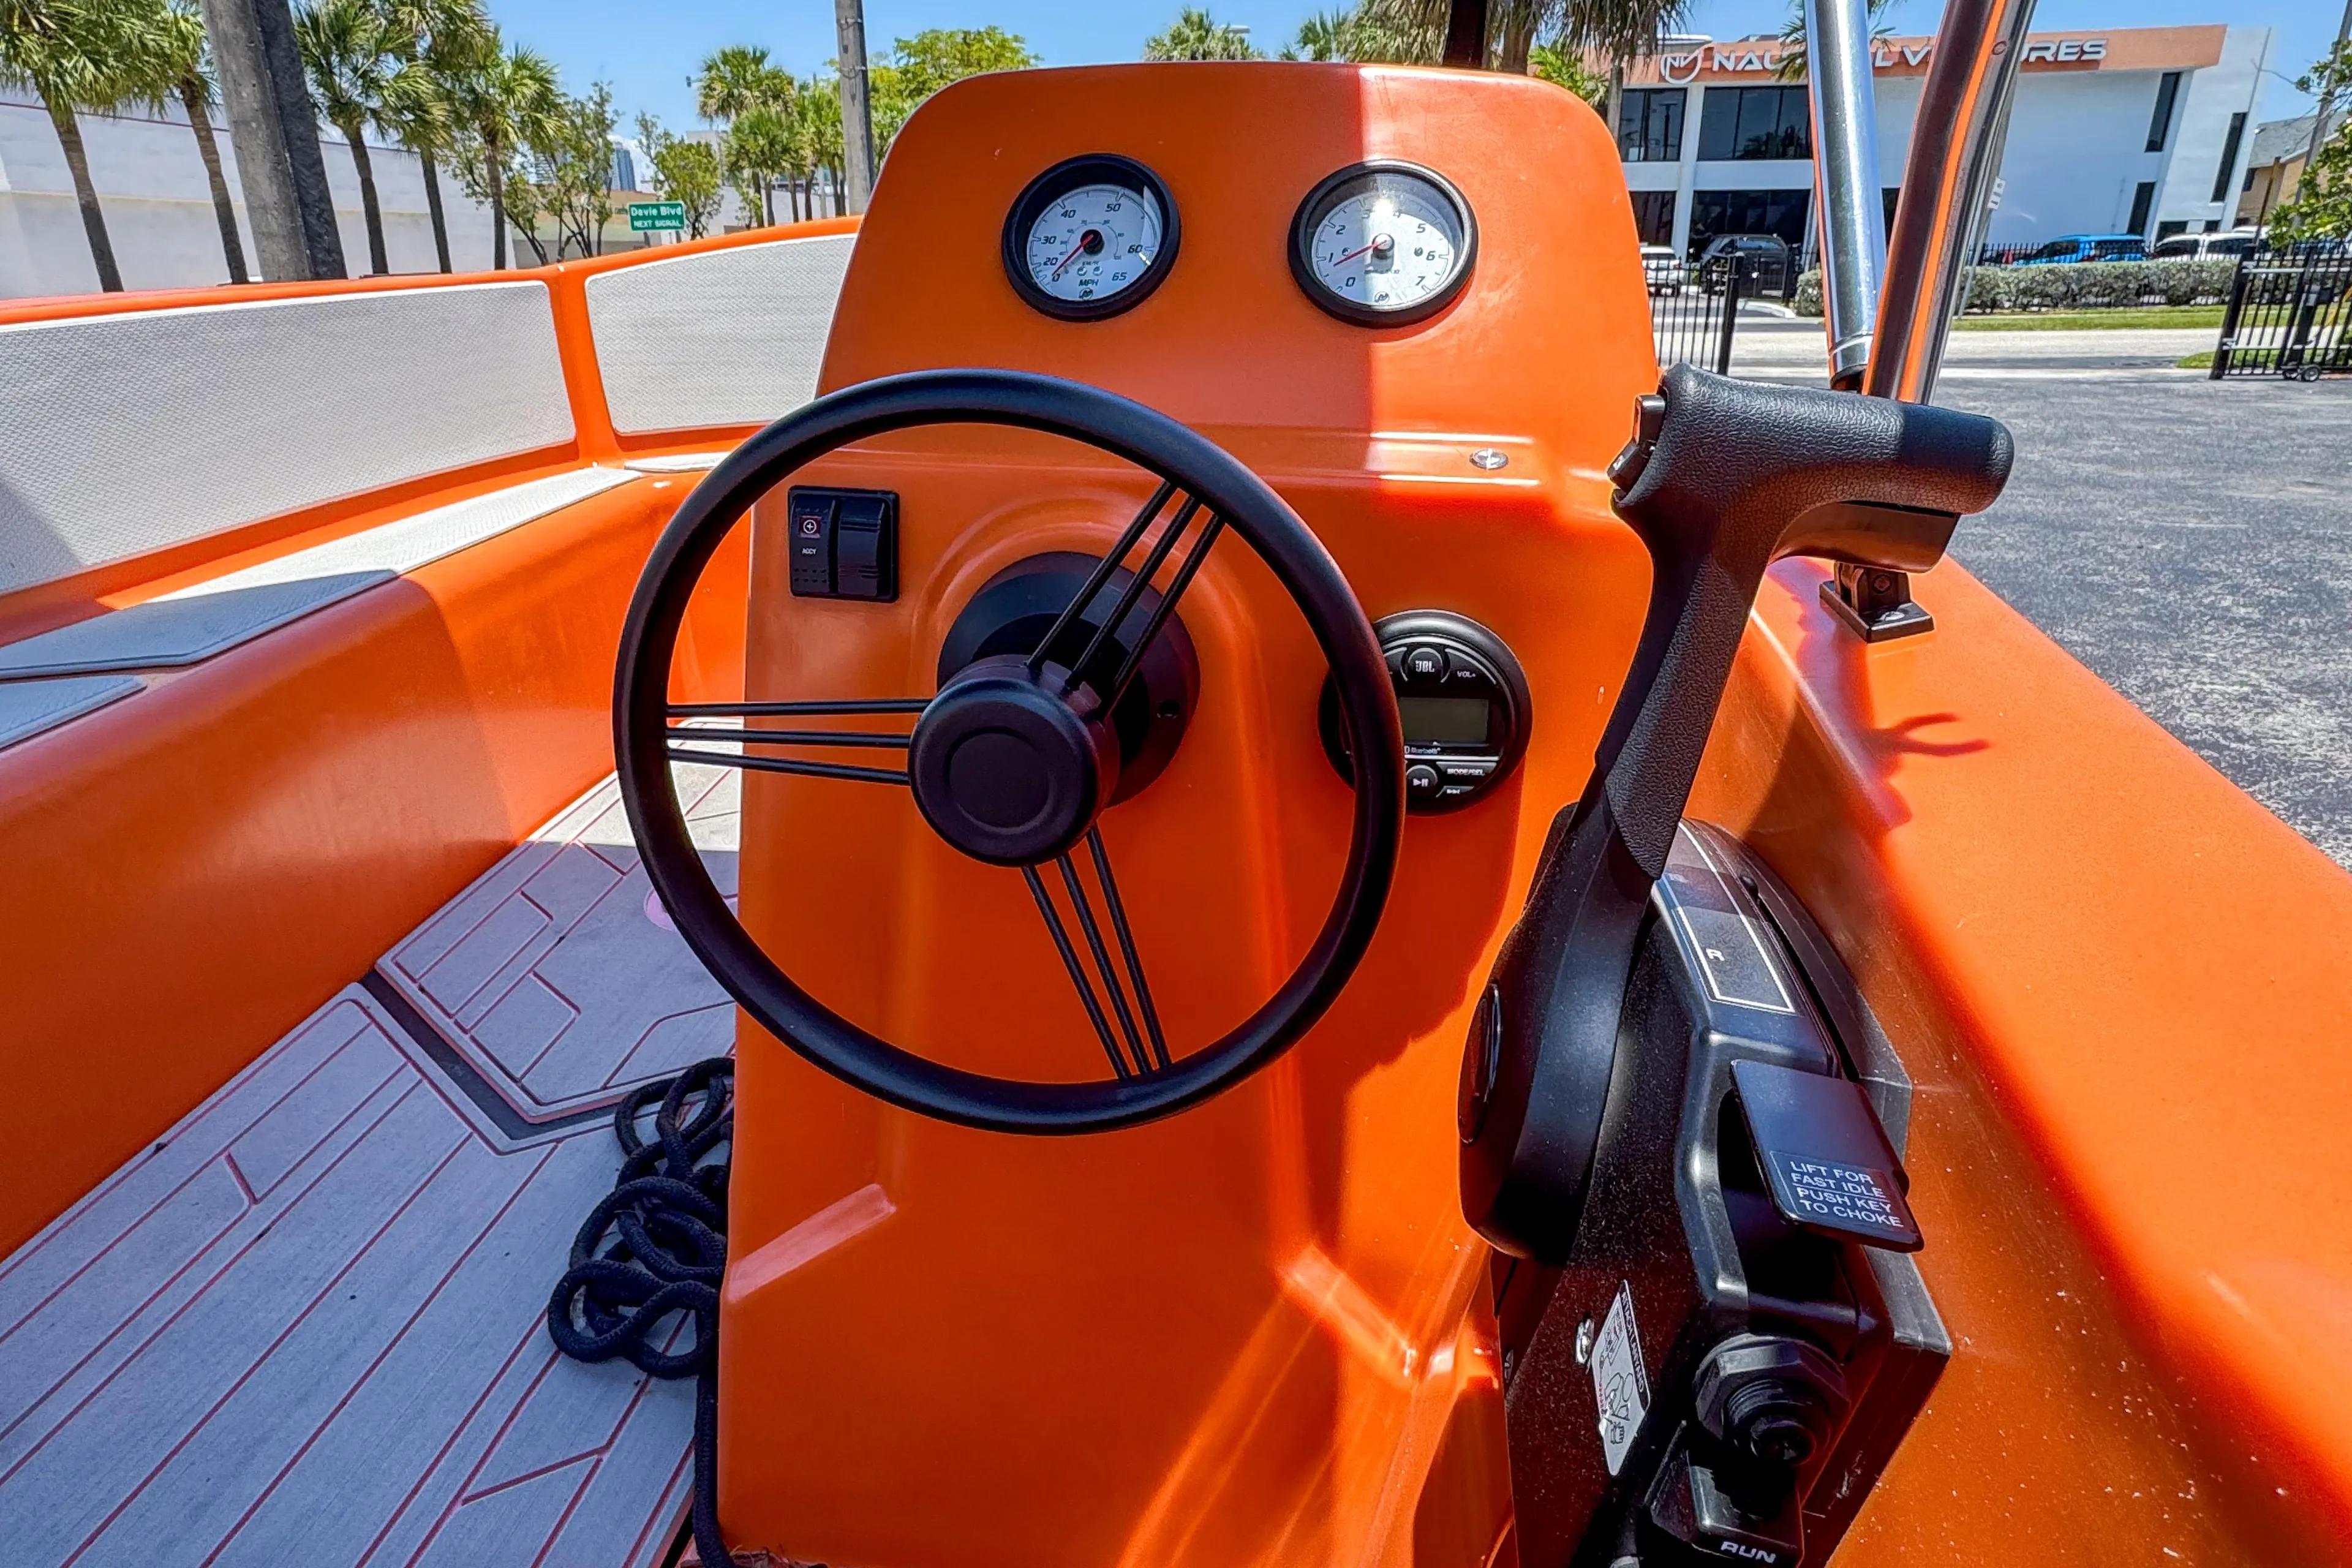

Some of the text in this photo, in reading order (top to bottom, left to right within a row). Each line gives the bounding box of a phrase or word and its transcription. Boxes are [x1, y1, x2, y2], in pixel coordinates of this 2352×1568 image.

[630, 206, 658, 216] Davie
[660, 206, 682, 216] Blvd
[1105, 203, 1121, 212] 50
[655, 219, 682, 228] SIGNAL
[1416, 224, 1426, 233] 5
[1336, 225, 1346, 235] 2
[1041, 236, 1057, 244] 30
[1128, 244, 1144, 254] 60
[1329, 252, 1333, 263] 1
[1426, 251, 1436, 261] 6
[1043, 257, 1058, 266] 20
[1112, 272, 1128, 281] 65
[1415, 276, 1425, 286] 7
[1346, 277, 1355, 287] 0
[1415, 660, 1434, 673] JBL
[1706, 948, 1725, 961] R
[1790, 1161, 1874, 1185] LIFT FOR
[1791, 1172, 1887, 1198] FAST IDLE
[1796, 1187, 1891, 1213] PUSH KEY
[1800, 1199, 1904, 1228] TO CHOKE
[1721, 1541, 1776, 1563] RUN
